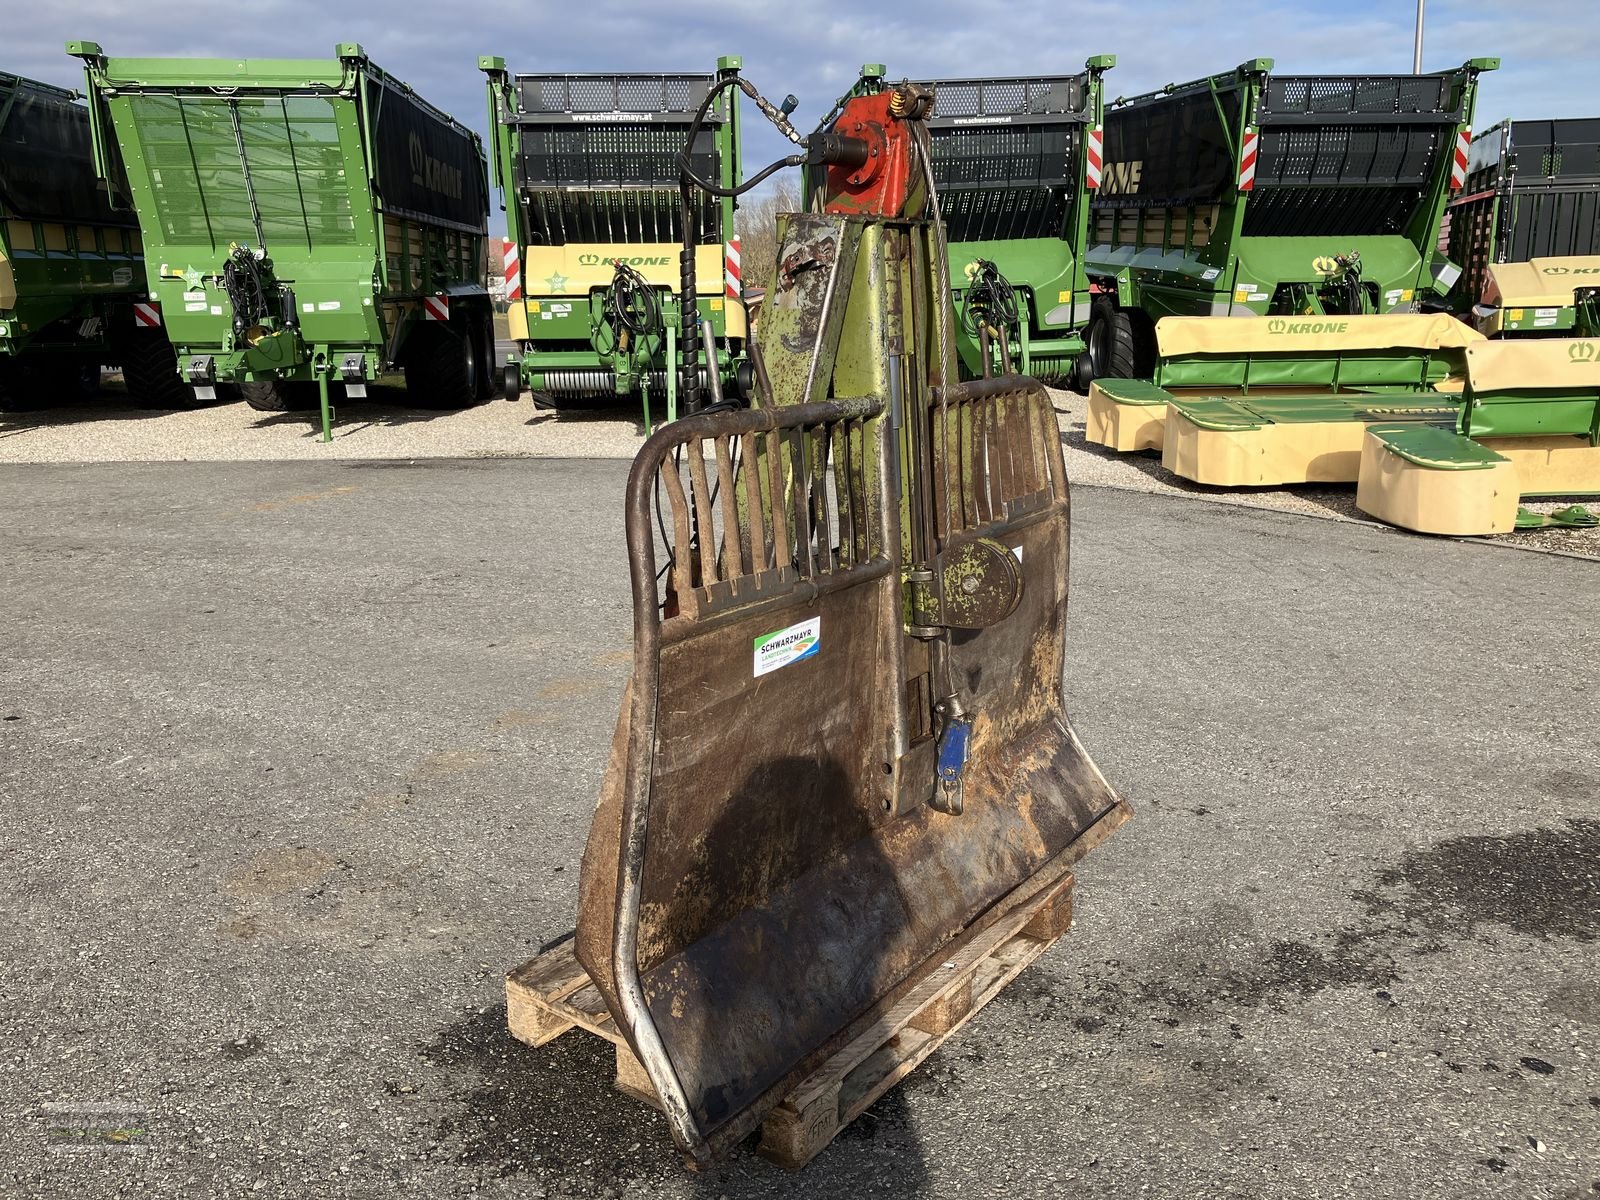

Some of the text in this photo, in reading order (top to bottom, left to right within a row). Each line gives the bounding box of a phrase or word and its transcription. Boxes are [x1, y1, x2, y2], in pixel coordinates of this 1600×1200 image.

[572, 112, 653, 122] www.schwarzmayr.at
[424, 153, 462, 200] KRONE
[1095, 160, 1144, 197] ONE
[1286, 322, 1349, 335] KRONE
[761, 628, 812, 654] SCHWARZMAYR
